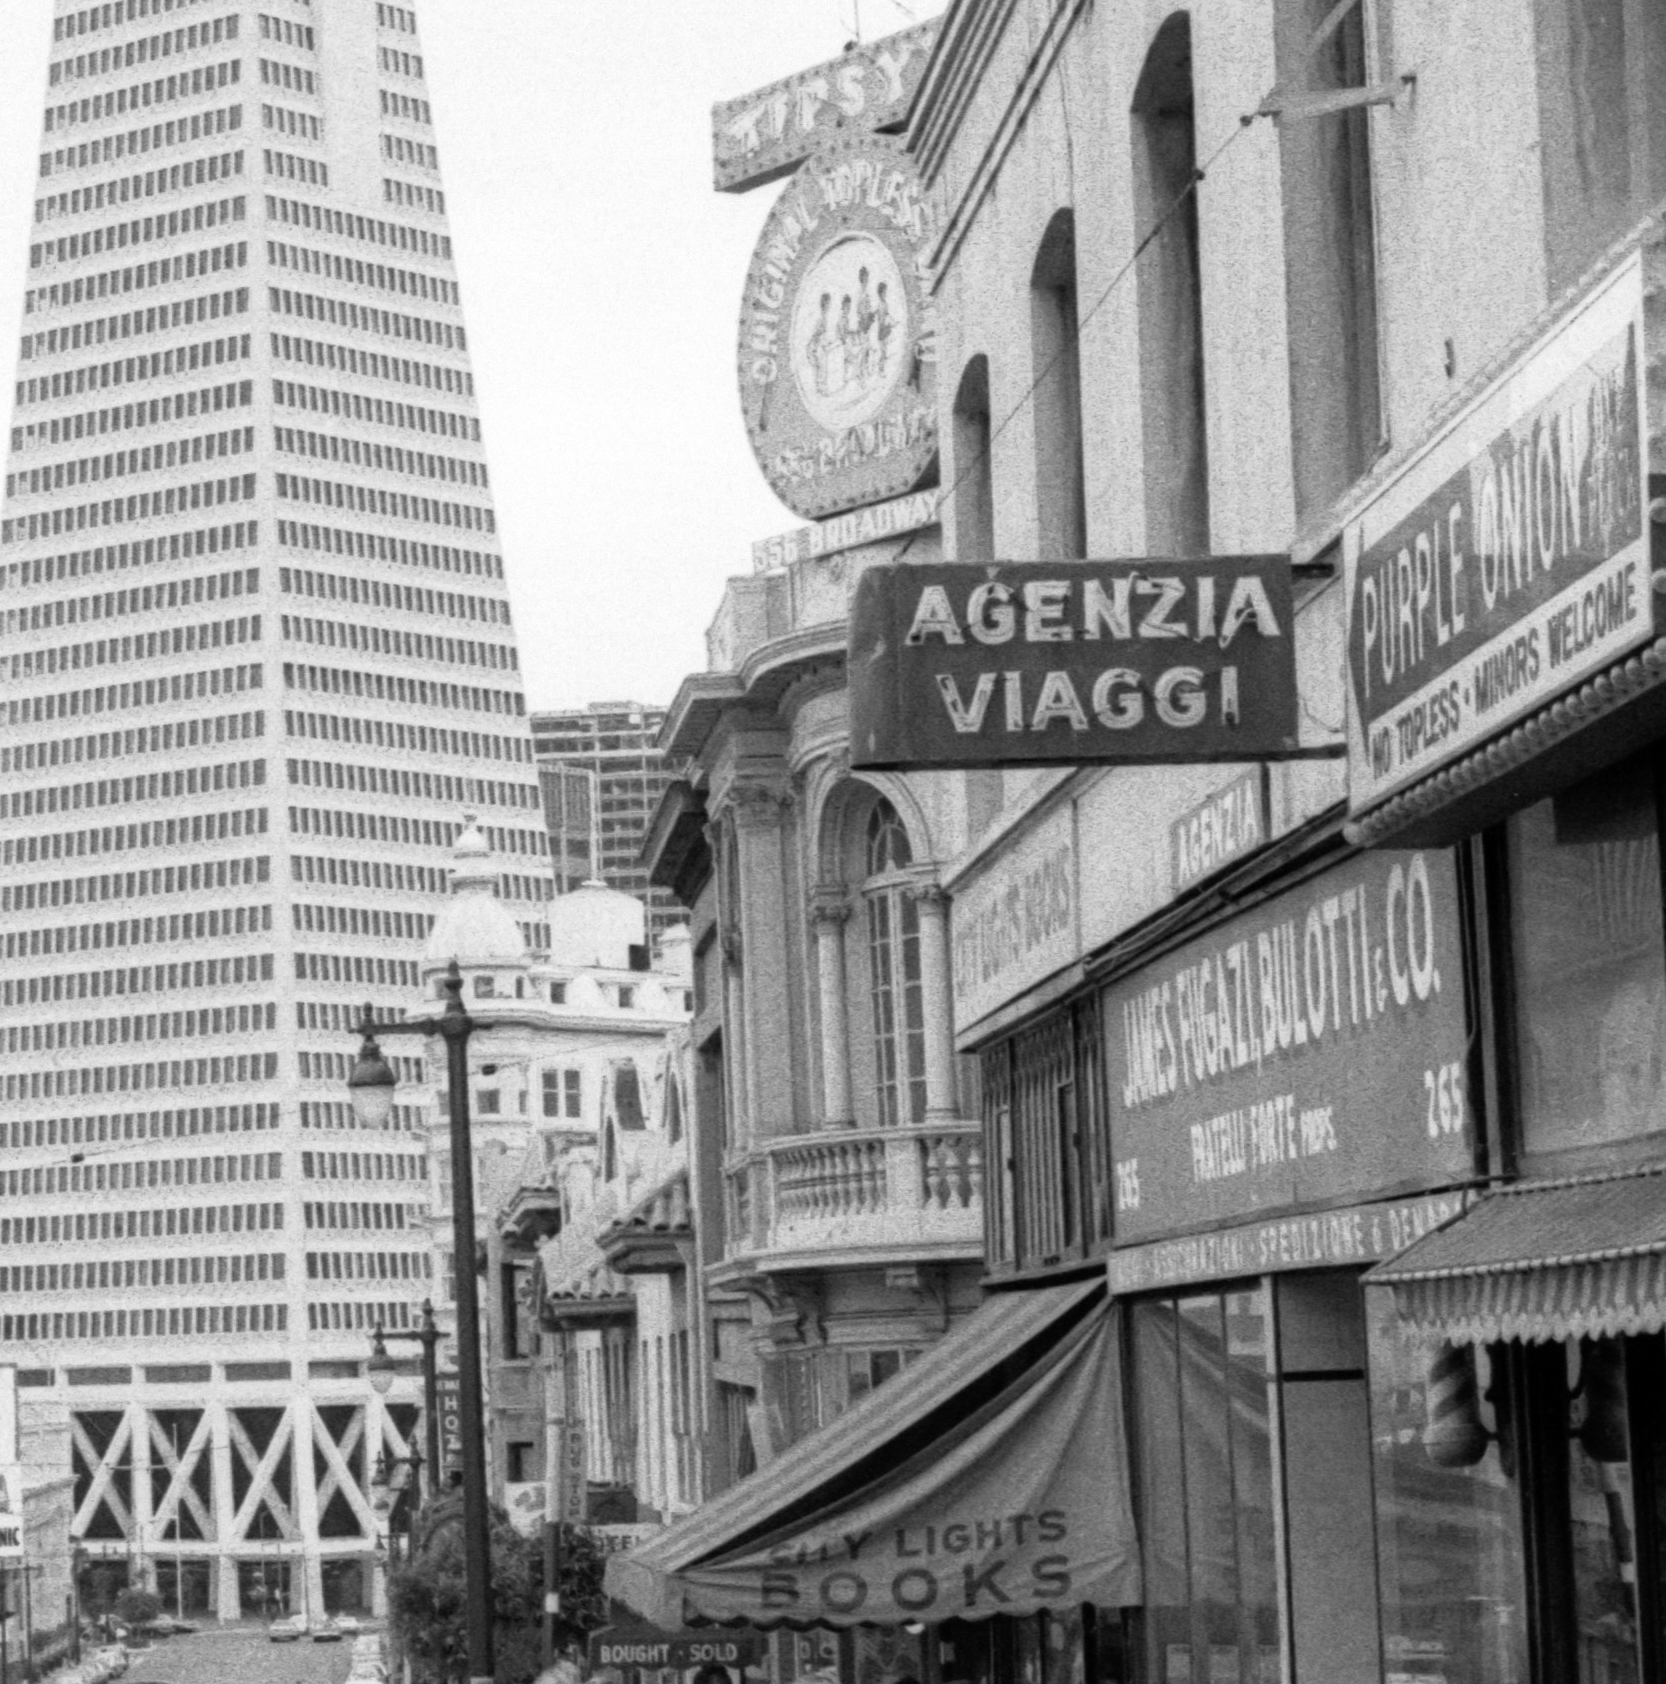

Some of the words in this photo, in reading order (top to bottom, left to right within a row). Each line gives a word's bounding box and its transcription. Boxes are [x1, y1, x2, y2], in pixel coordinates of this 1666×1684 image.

[808, 489, 940, 559] BROADWAY
[1362, 501, 1465, 699] PURPLE
[1479, 411, 1583, 611] ONION
[905, 574, 1282, 648] AGENZIA
[935, 666, 1240, 734] VIAGGI
[1370, 725, 1393, 781] NO
[1396, 679, 1461, 767] TOPLESS
[1474, 626, 1541, 716] MINORS
[1547, 561, 1638, 669] WELCOME
[1178, 778, 1259, 888] AGENZIA
[1122, 980, 1177, 1109] JAMES
[1258, 882, 1372, 1056] BULOTTI
[1387, 852, 1441, 1006] CO.
[1424, 1061, 1464, 1139] 265
[895, 1509, 1068, 1558] LIGHTS
[761, 1554, 1073, 1613] BOOKS
[600, 1644, 670, 1664] BOUGHT
[689, 1642, 739, 1662] SOLD
